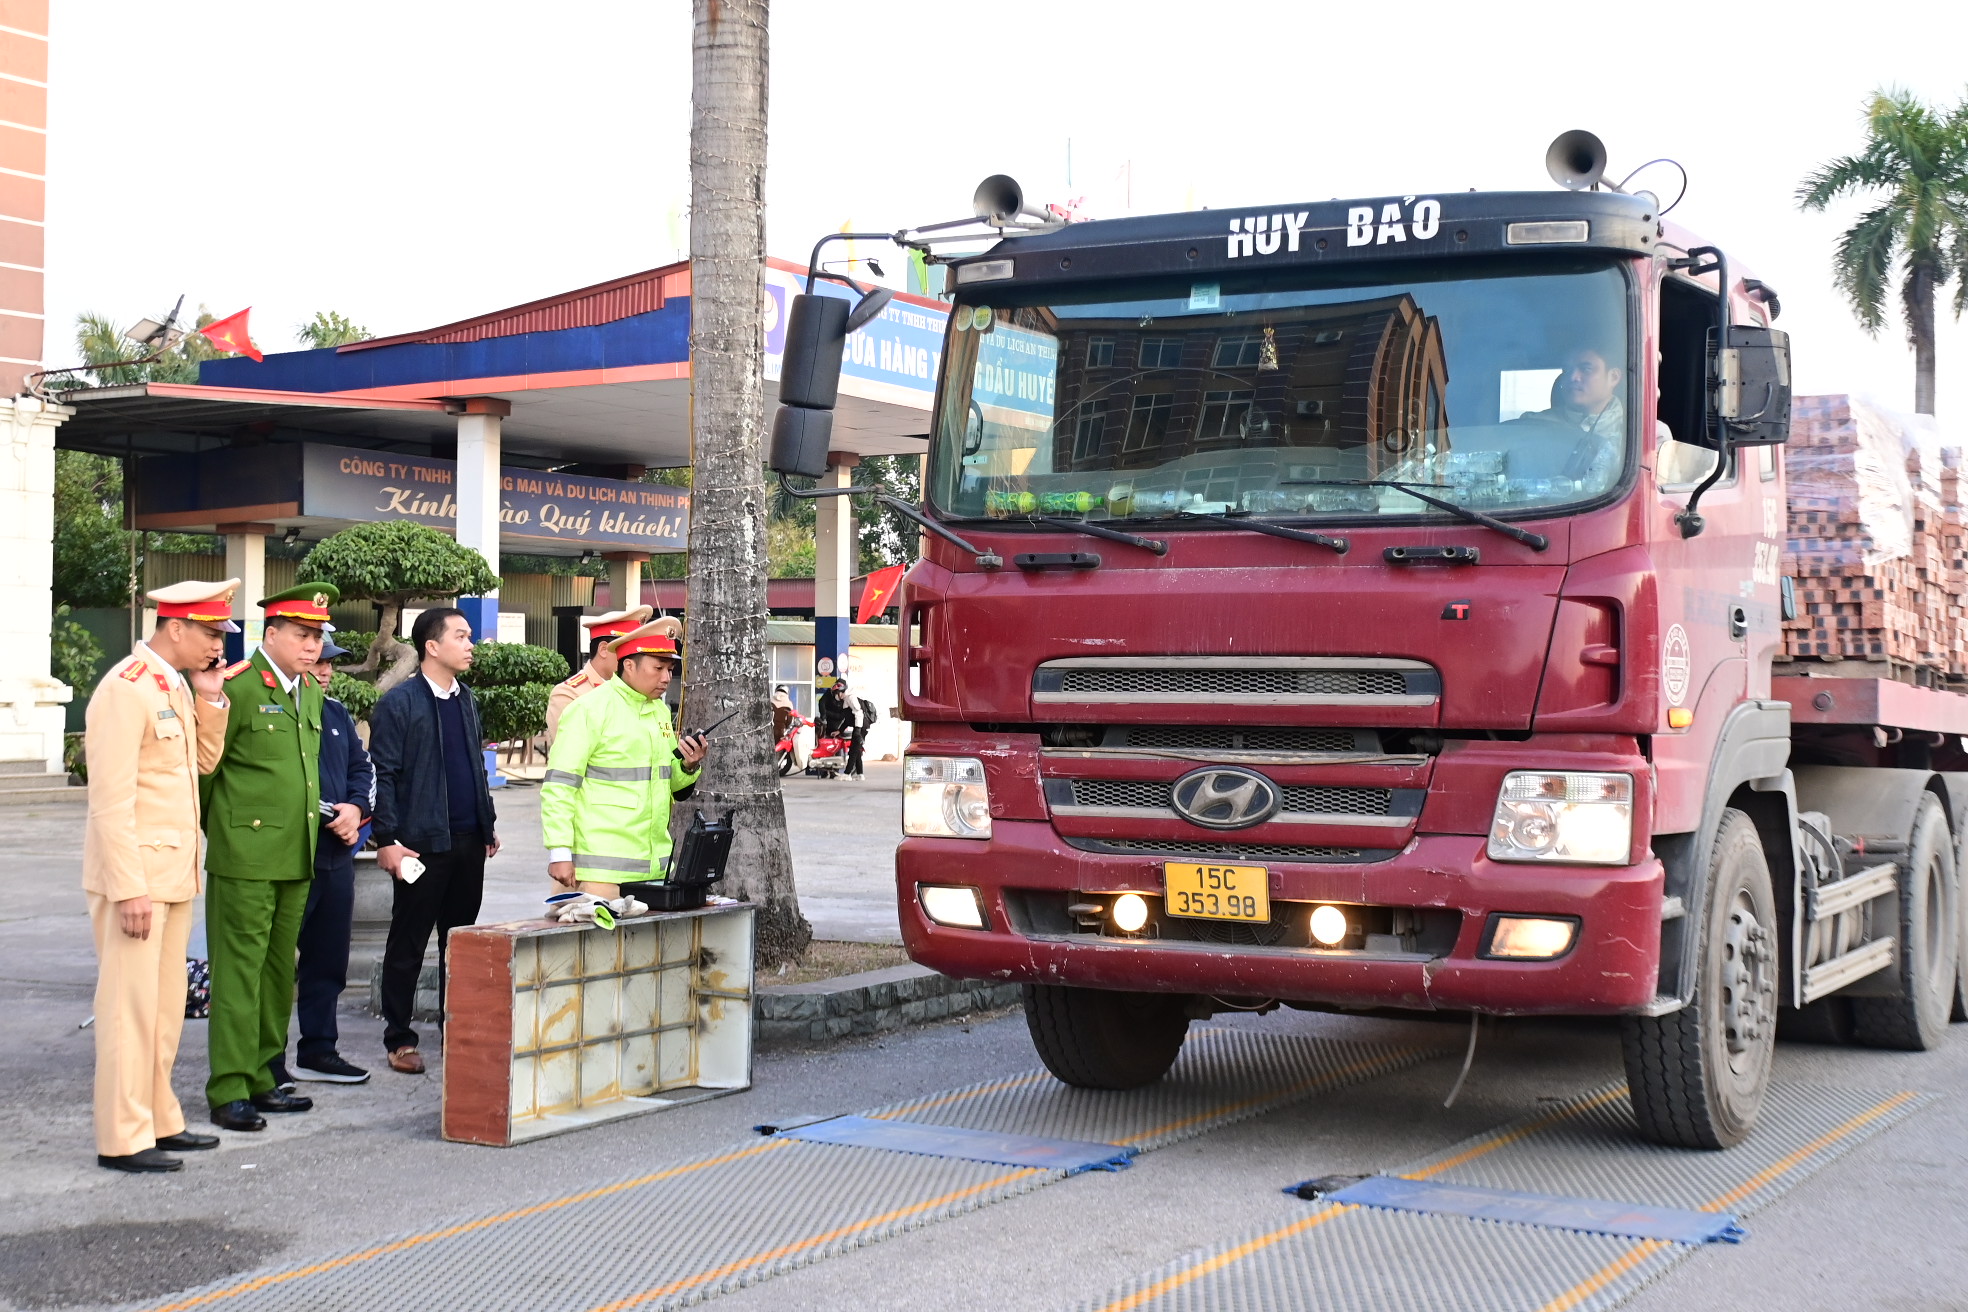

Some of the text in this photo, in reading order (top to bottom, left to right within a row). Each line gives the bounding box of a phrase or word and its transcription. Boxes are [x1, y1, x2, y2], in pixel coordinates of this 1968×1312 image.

[1227, 195, 1441, 259] HUY BẢO
[888, 307, 901, 323] TY
[902, 310, 926, 330] TNHH
[996, 335, 1006, 348] DU
[1007, 338, 1025, 354] LỊCH
[1025, 343, 1037, 356] AN
[880, 336, 928, 379] HÀNG
[985, 356, 1015, 396] DẦU
[1018, 369, 1055, 405] HUYỀ
[340, 456, 385, 477] CÔNG
[389, 464, 408, 479] TY
[412, 466, 452, 484] TNHH
[517, 478, 543, 498] MẠI
[545, 480, 564, 496] VÀ
[567, 484, 586, 499] DU
[589, 486, 616, 504] LỊCH
[619, 490, 637, 504] AN
[639, 492, 674, 510] THỊNH
[677, 496, 690, 509] PH
[375, 486, 682, 538] Kính ào Quý khách!
[1177, 891, 1256, 918] 353.98
[1196, 867, 1236, 890] 15C
